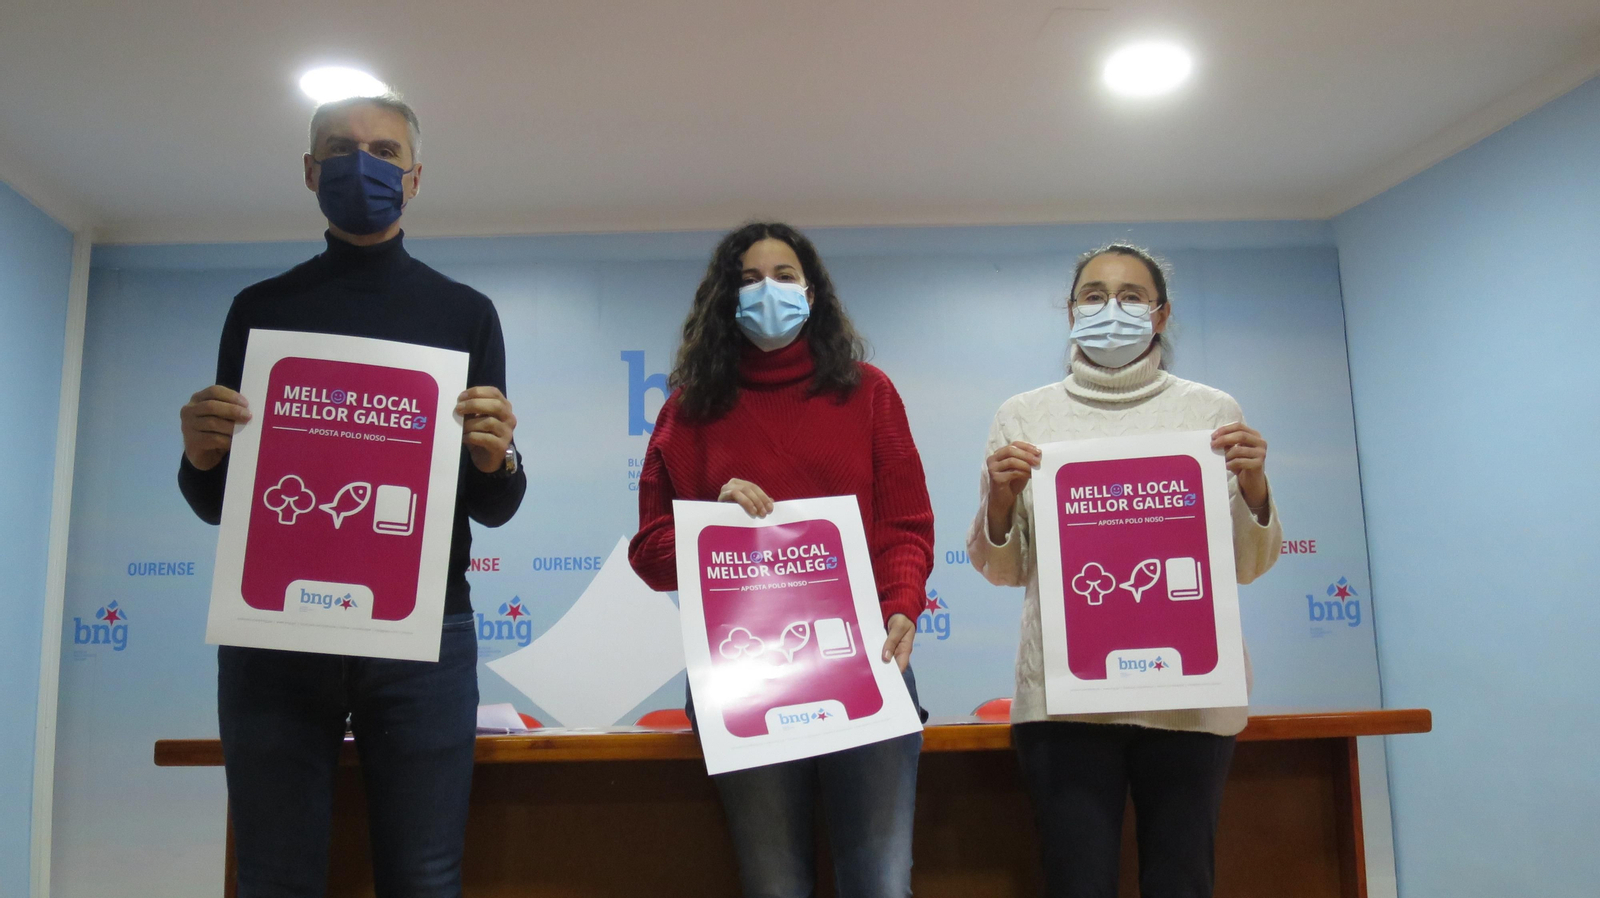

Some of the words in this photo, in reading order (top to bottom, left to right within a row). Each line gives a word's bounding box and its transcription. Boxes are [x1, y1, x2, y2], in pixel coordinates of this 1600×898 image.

[283, 385, 357, 406] MELLOR
[362, 393, 421, 413] LOCAL
[274, 401, 349, 422] MELLOR
[308, 427, 339, 437] APOSTA
[340, 431, 362, 440] POLO
[363, 433, 386, 442] NOSO
[1070, 483, 1134, 499] MELLOR
[1137, 480, 1189, 495] LOCAL
[1065, 499, 1129, 515] MELLOR
[1125, 517, 1143, 525] POLO
[711, 550, 774, 564] MELLOR
[777, 543, 830, 560] LOCAL
[1280, 540, 1317, 554] ENSE
[465, 558, 500, 572] NSE
[532, 556, 602, 571] OURENSE
[945, 550, 971, 565] OU
[127, 562, 195, 576] OURENSE
[706, 565, 770, 579] MELLOR
[787, 580, 808, 588] NOSO
[300, 588, 333, 609] bng
[1306, 594, 1361, 627] bng
[476, 613, 532, 647] bng
[915, 612, 951, 640] ng
[74, 617, 128, 651] bng
[1118, 657, 1147, 672] bng
[778, 712, 810, 725] bng
